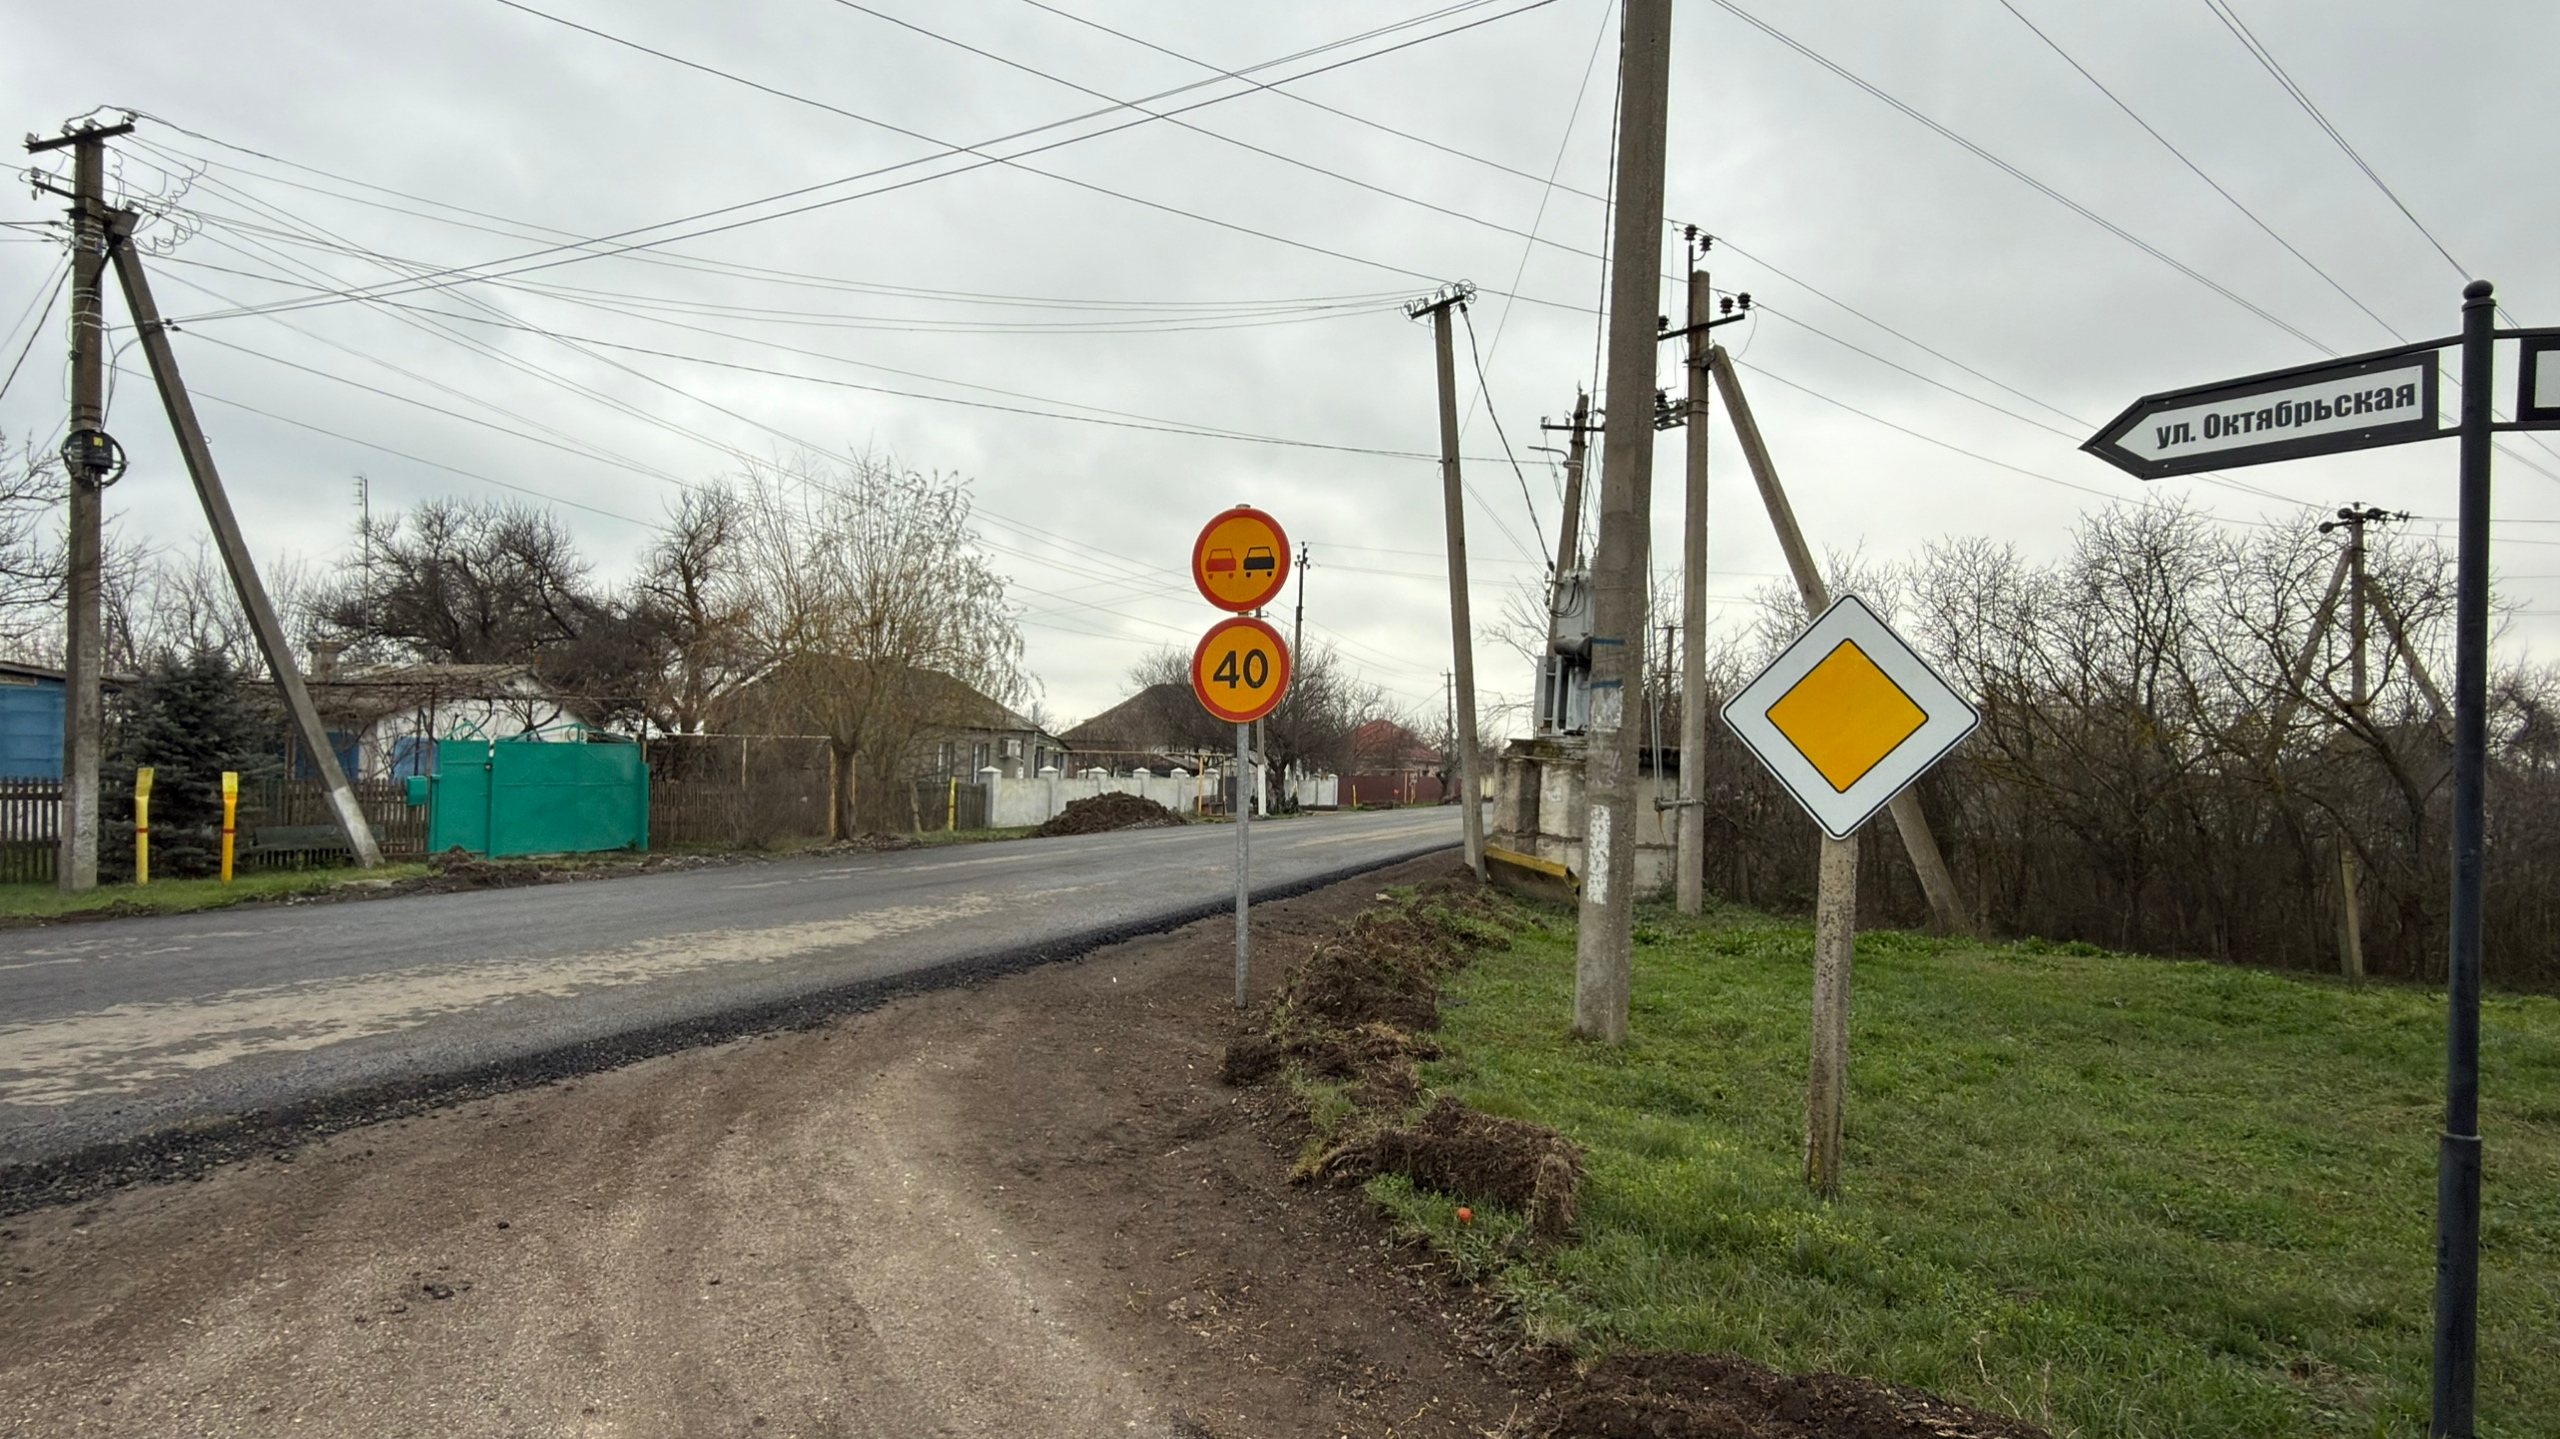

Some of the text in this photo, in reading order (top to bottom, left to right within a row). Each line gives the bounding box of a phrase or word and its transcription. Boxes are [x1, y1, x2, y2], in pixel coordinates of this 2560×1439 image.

[2156, 383, 2416, 450] ул. Октябрьская
[1212, 648, 1269, 689] 40
